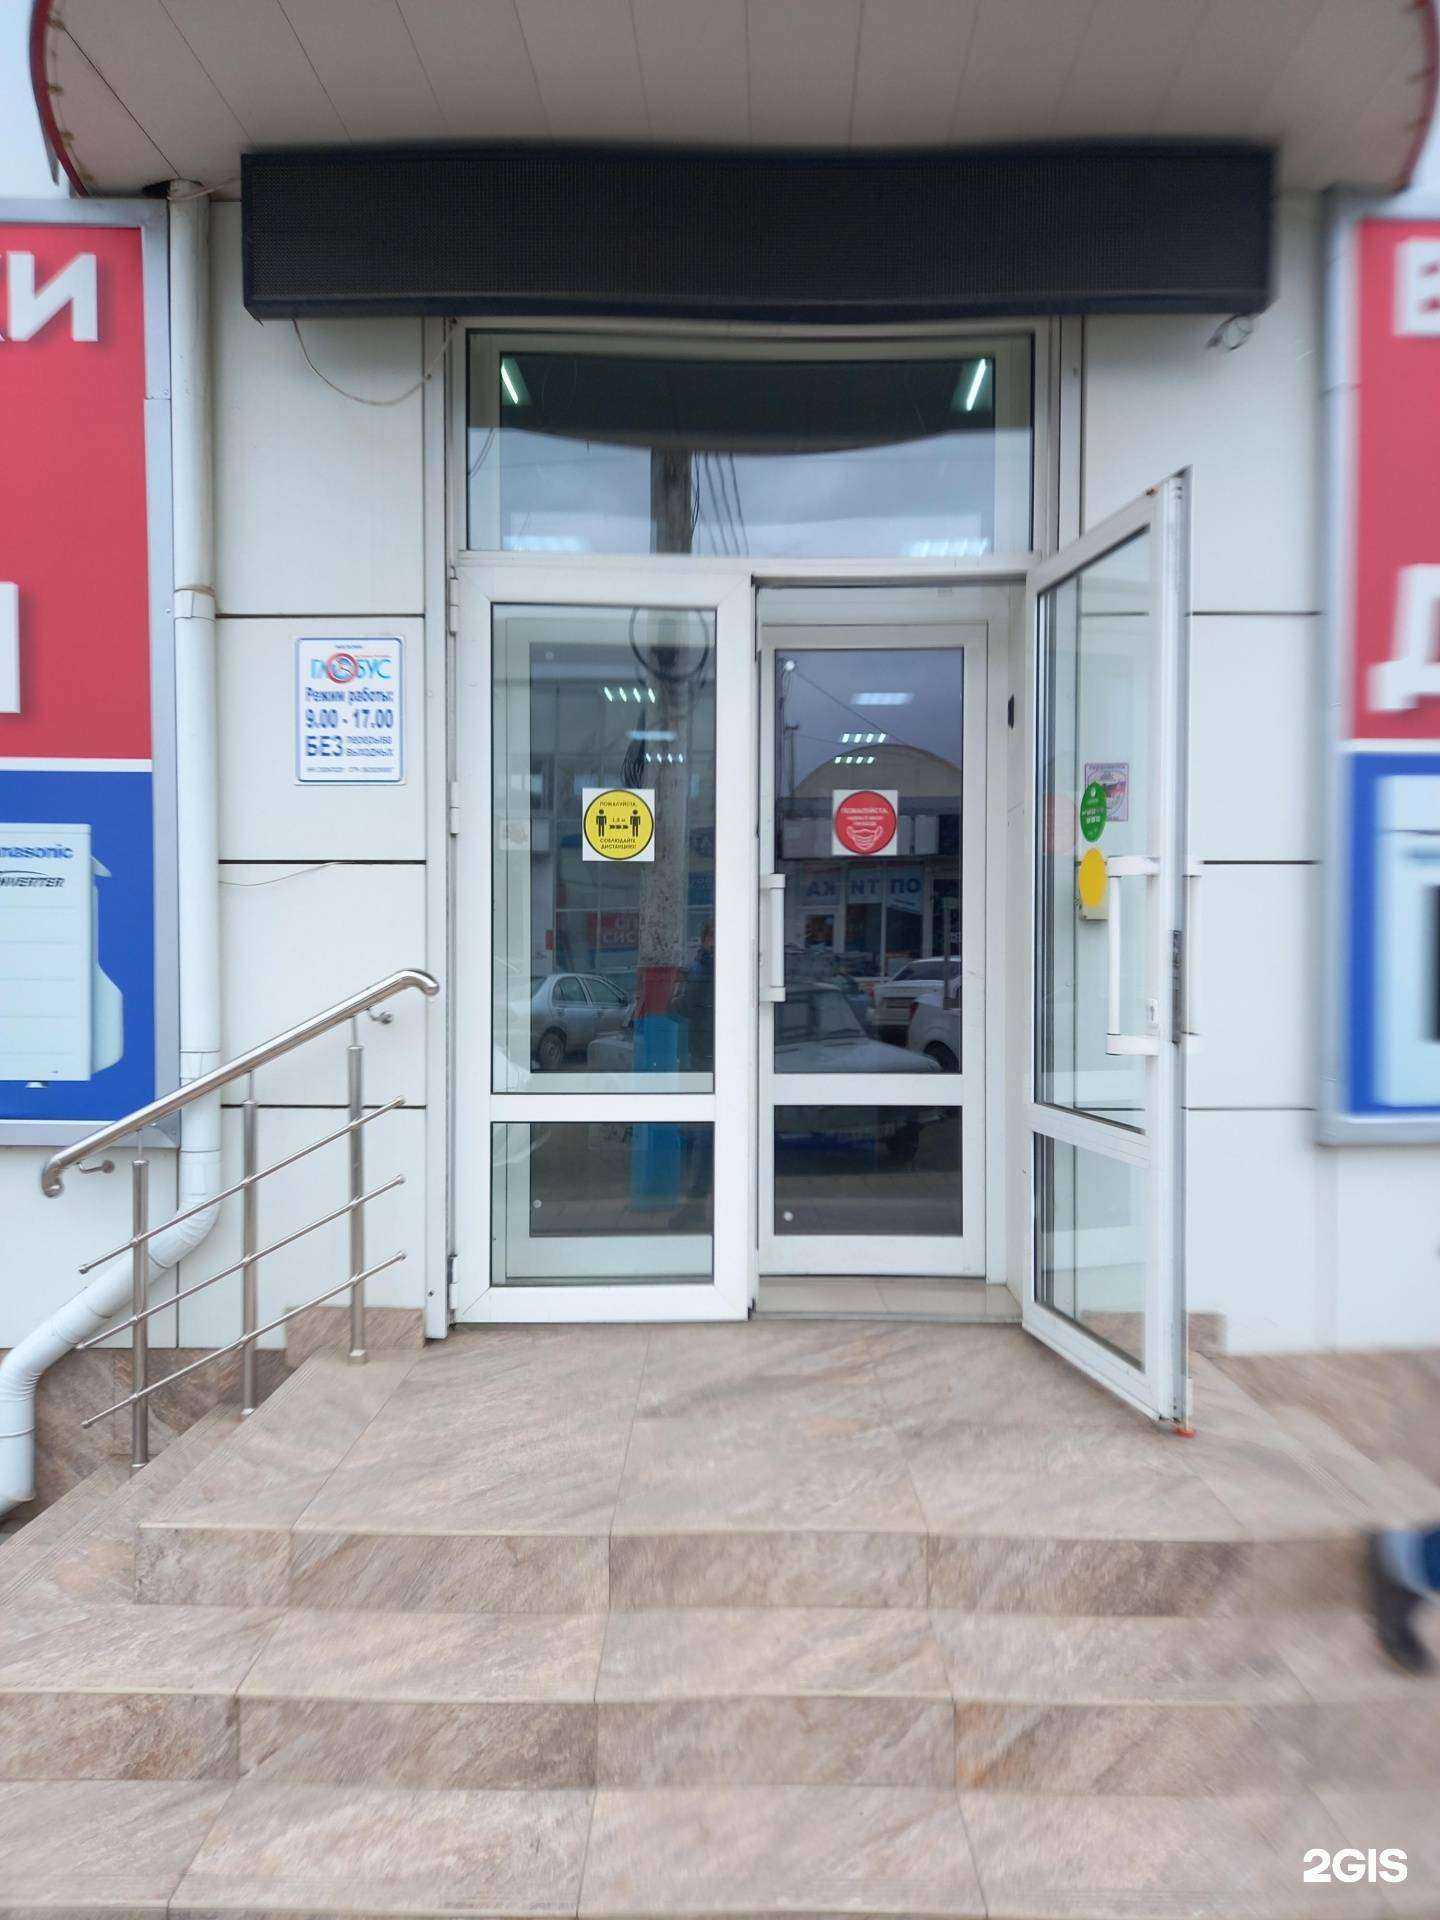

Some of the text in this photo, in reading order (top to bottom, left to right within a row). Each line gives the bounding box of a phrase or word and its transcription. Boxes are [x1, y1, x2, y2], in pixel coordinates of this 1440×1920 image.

[0, 251, 98, 341] И
[305, 687, 346, 702] Режим
[305, 708, 338, 729] 9.00
[353, 708, 394, 729] 17.00
[306, 735, 343, 757] БЕЗ
